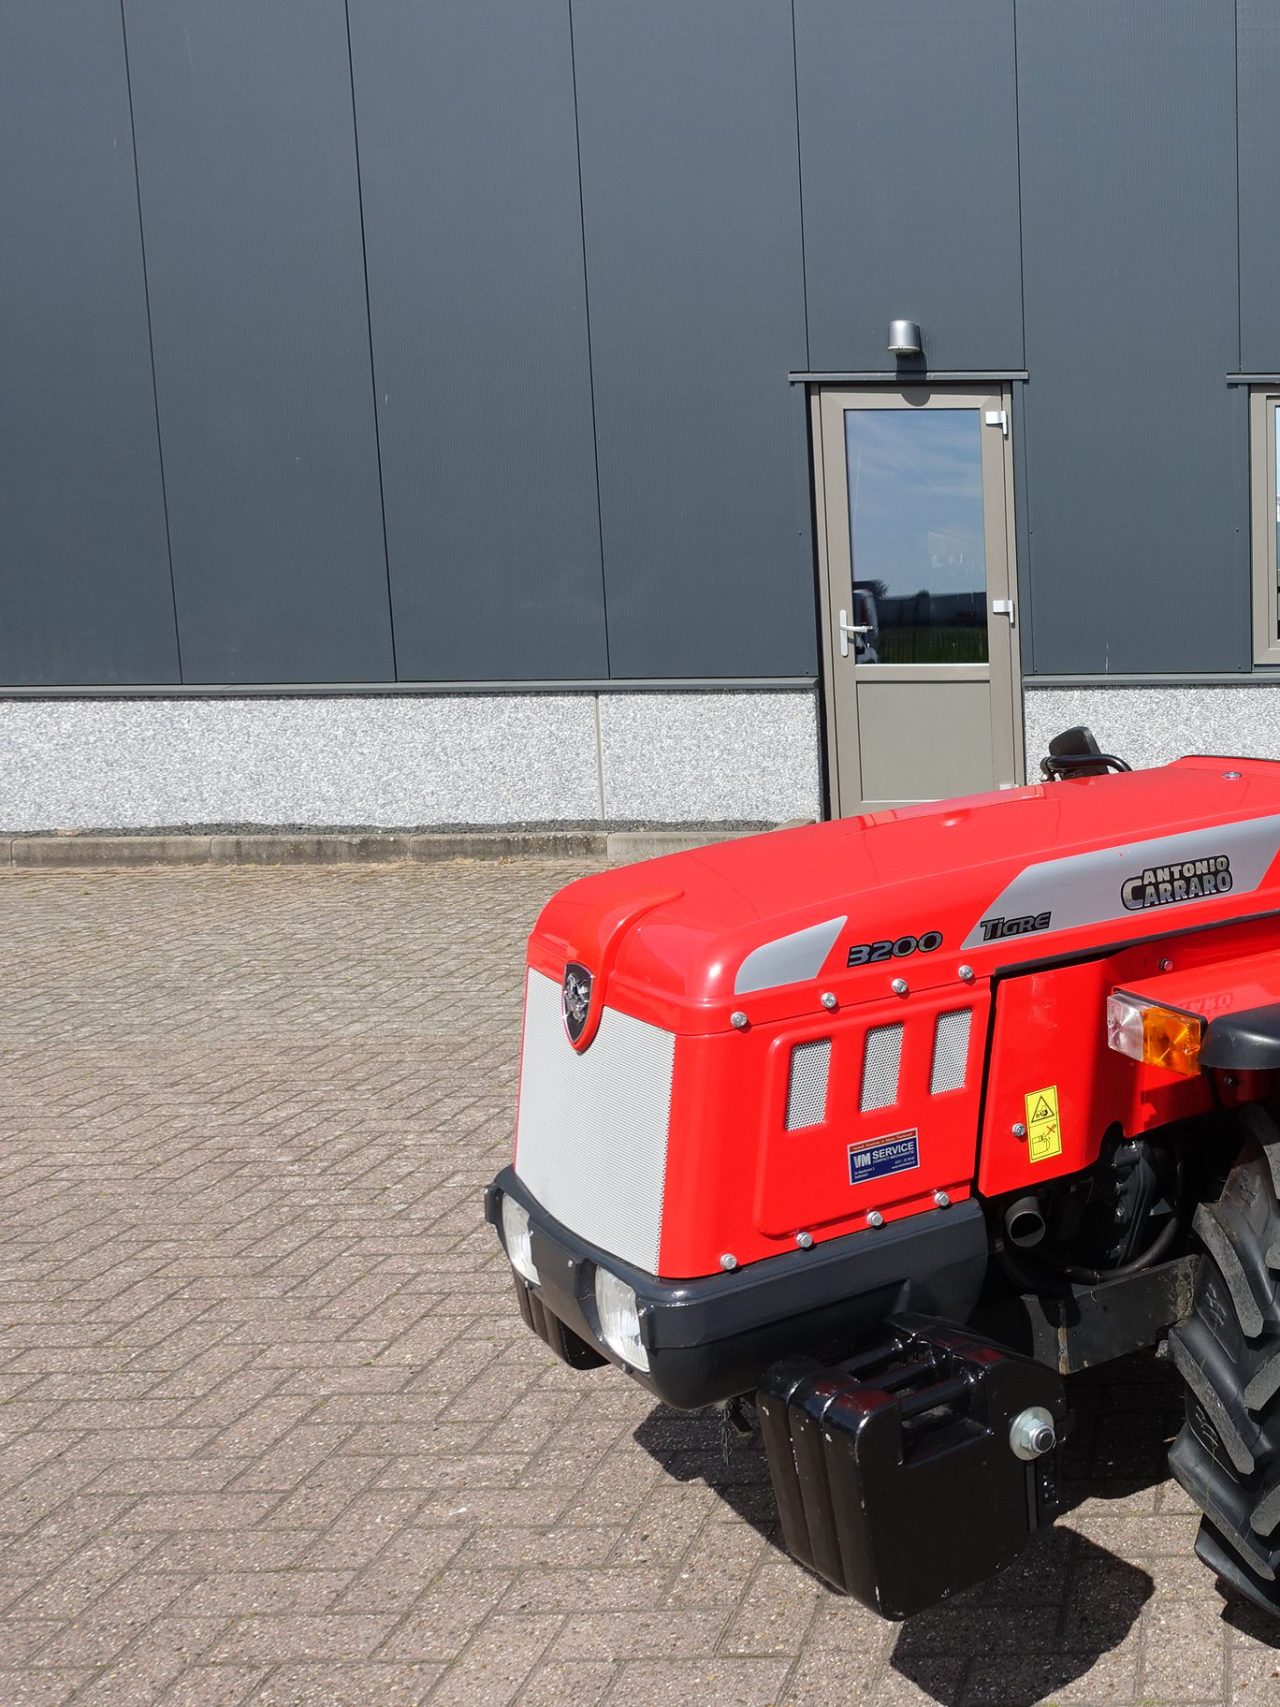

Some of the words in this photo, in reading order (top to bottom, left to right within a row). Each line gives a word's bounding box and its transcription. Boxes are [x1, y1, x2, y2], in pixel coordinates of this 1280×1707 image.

[1142, 856, 1229, 886] ANTONIO
[1121, 870, 1232, 910] CARRARO
[848, 931, 943, 967] 3200
[872, 1141, 915, 1160] SERVICE
